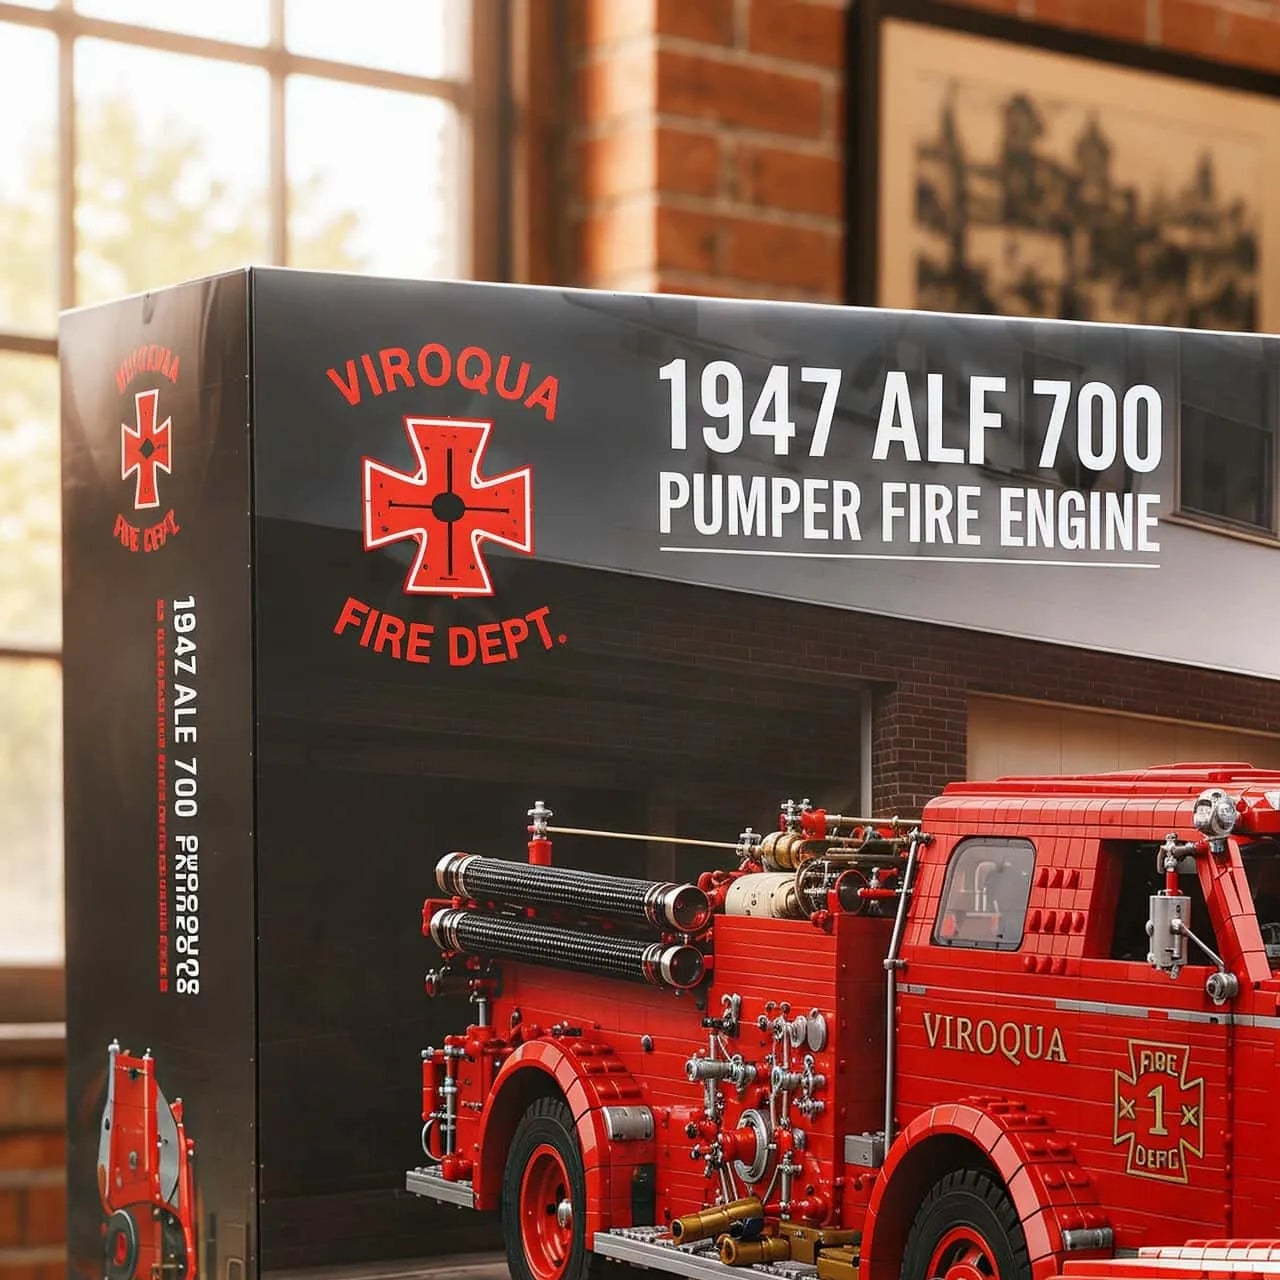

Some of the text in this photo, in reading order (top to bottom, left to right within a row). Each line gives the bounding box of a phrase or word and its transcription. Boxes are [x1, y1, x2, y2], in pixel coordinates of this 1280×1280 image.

[326, 343, 559, 421] VIROQUA
[658, 357, 1164, 473] 1947 ALF 700
[658, 471, 1162, 552] PUMPER FIRE ENGINE
[333, 596, 568, 667] FIRE DEPT.
[174, 757, 199, 818] 700
[922, 1012, 1069, 1066] VIROQUA
